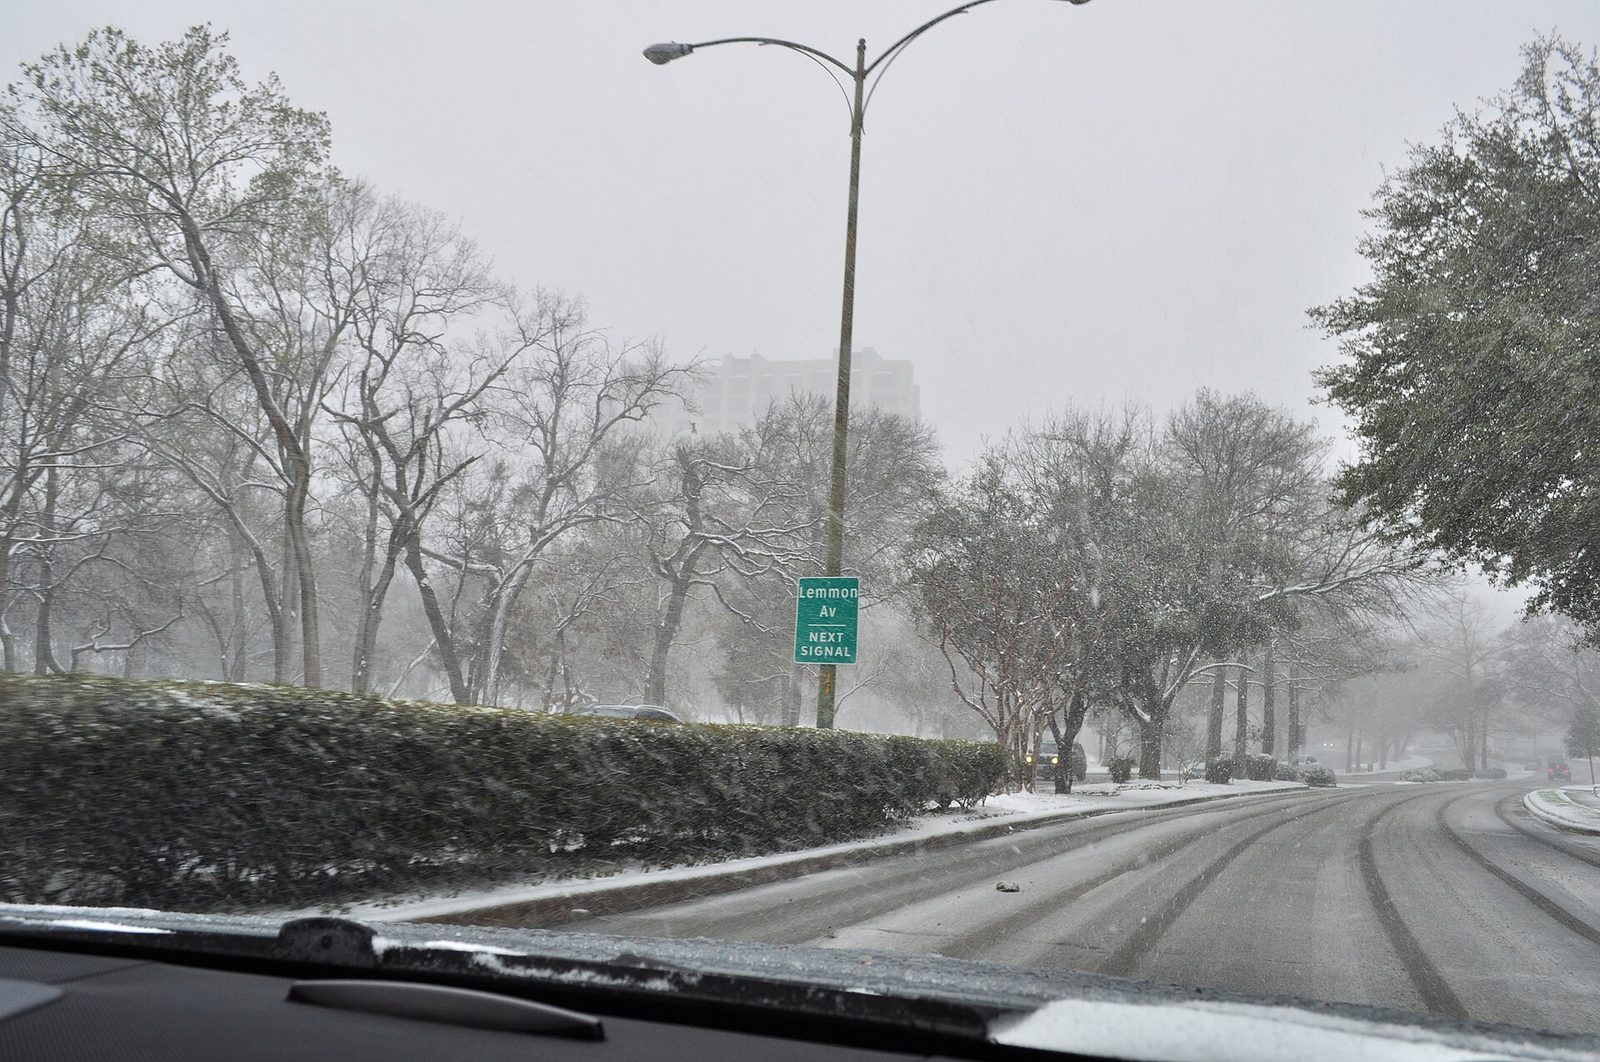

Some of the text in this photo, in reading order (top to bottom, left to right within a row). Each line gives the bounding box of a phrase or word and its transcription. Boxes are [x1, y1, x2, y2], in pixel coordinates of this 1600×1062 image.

[799, 586, 858, 599] Lemmon
[819, 605, 837, 618] Av
[809, 632, 844, 643] NEXT
[800, 645, 851, 657] SIGNAL
